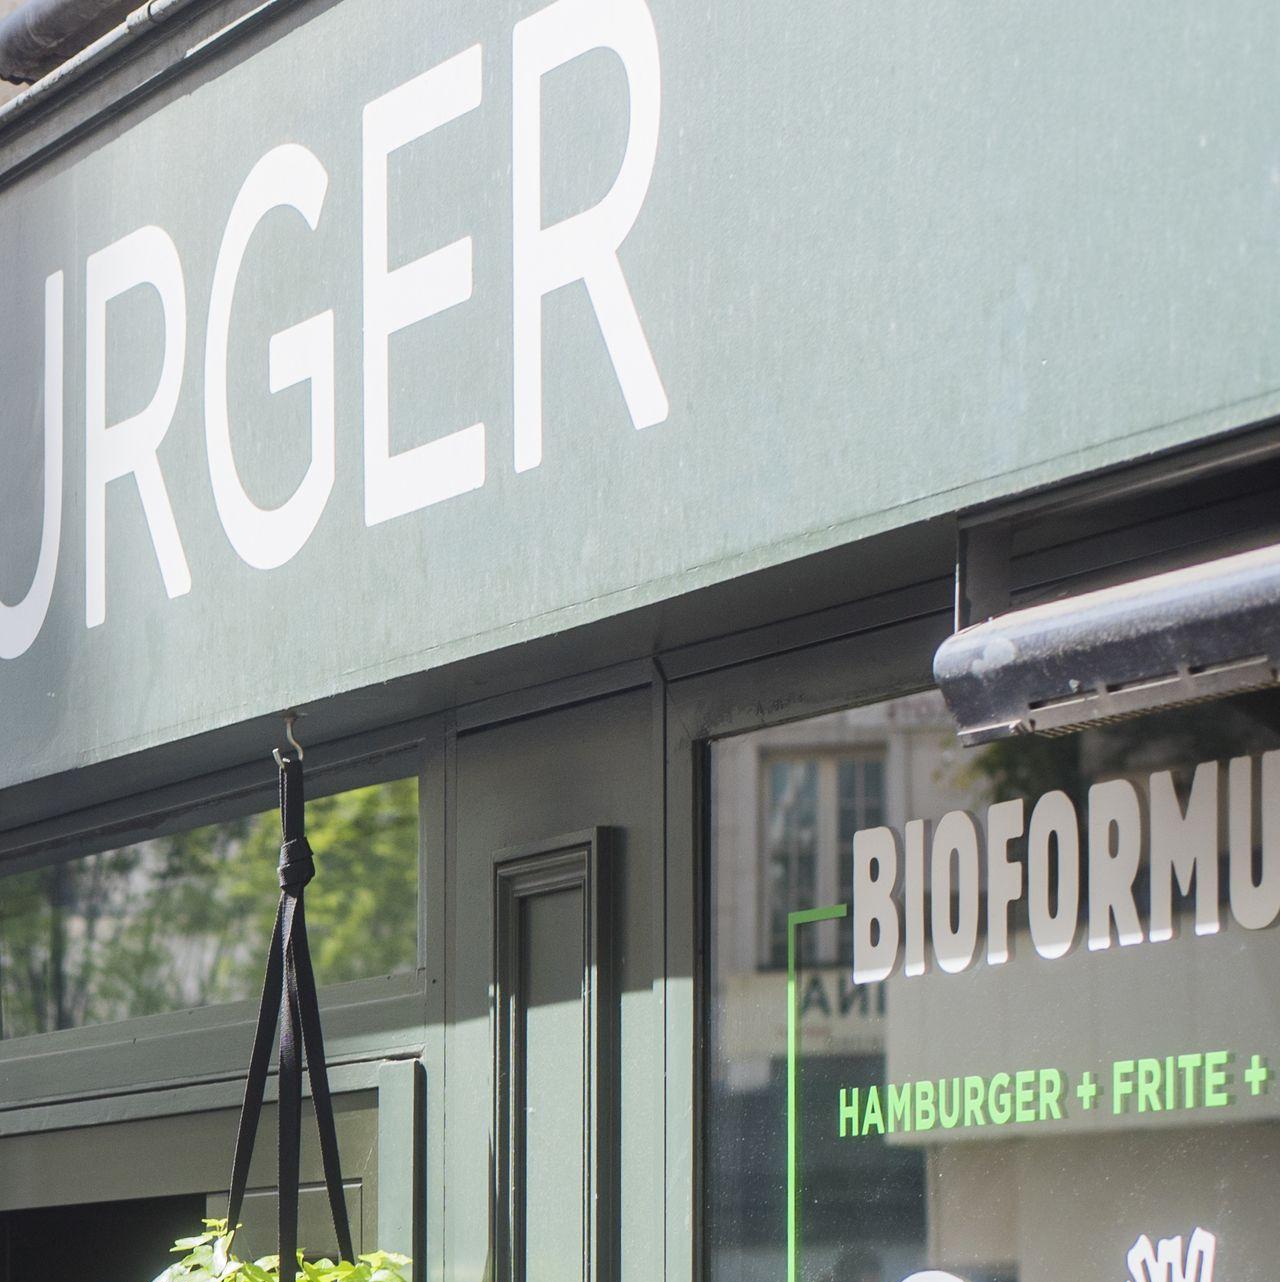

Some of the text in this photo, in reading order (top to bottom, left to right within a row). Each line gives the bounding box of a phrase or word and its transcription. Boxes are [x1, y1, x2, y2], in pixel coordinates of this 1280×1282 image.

[853, 750, 1280, 985] BIOFORMU
[839, 1051, 1267, 1137] HAMBURGER + FRITE +
